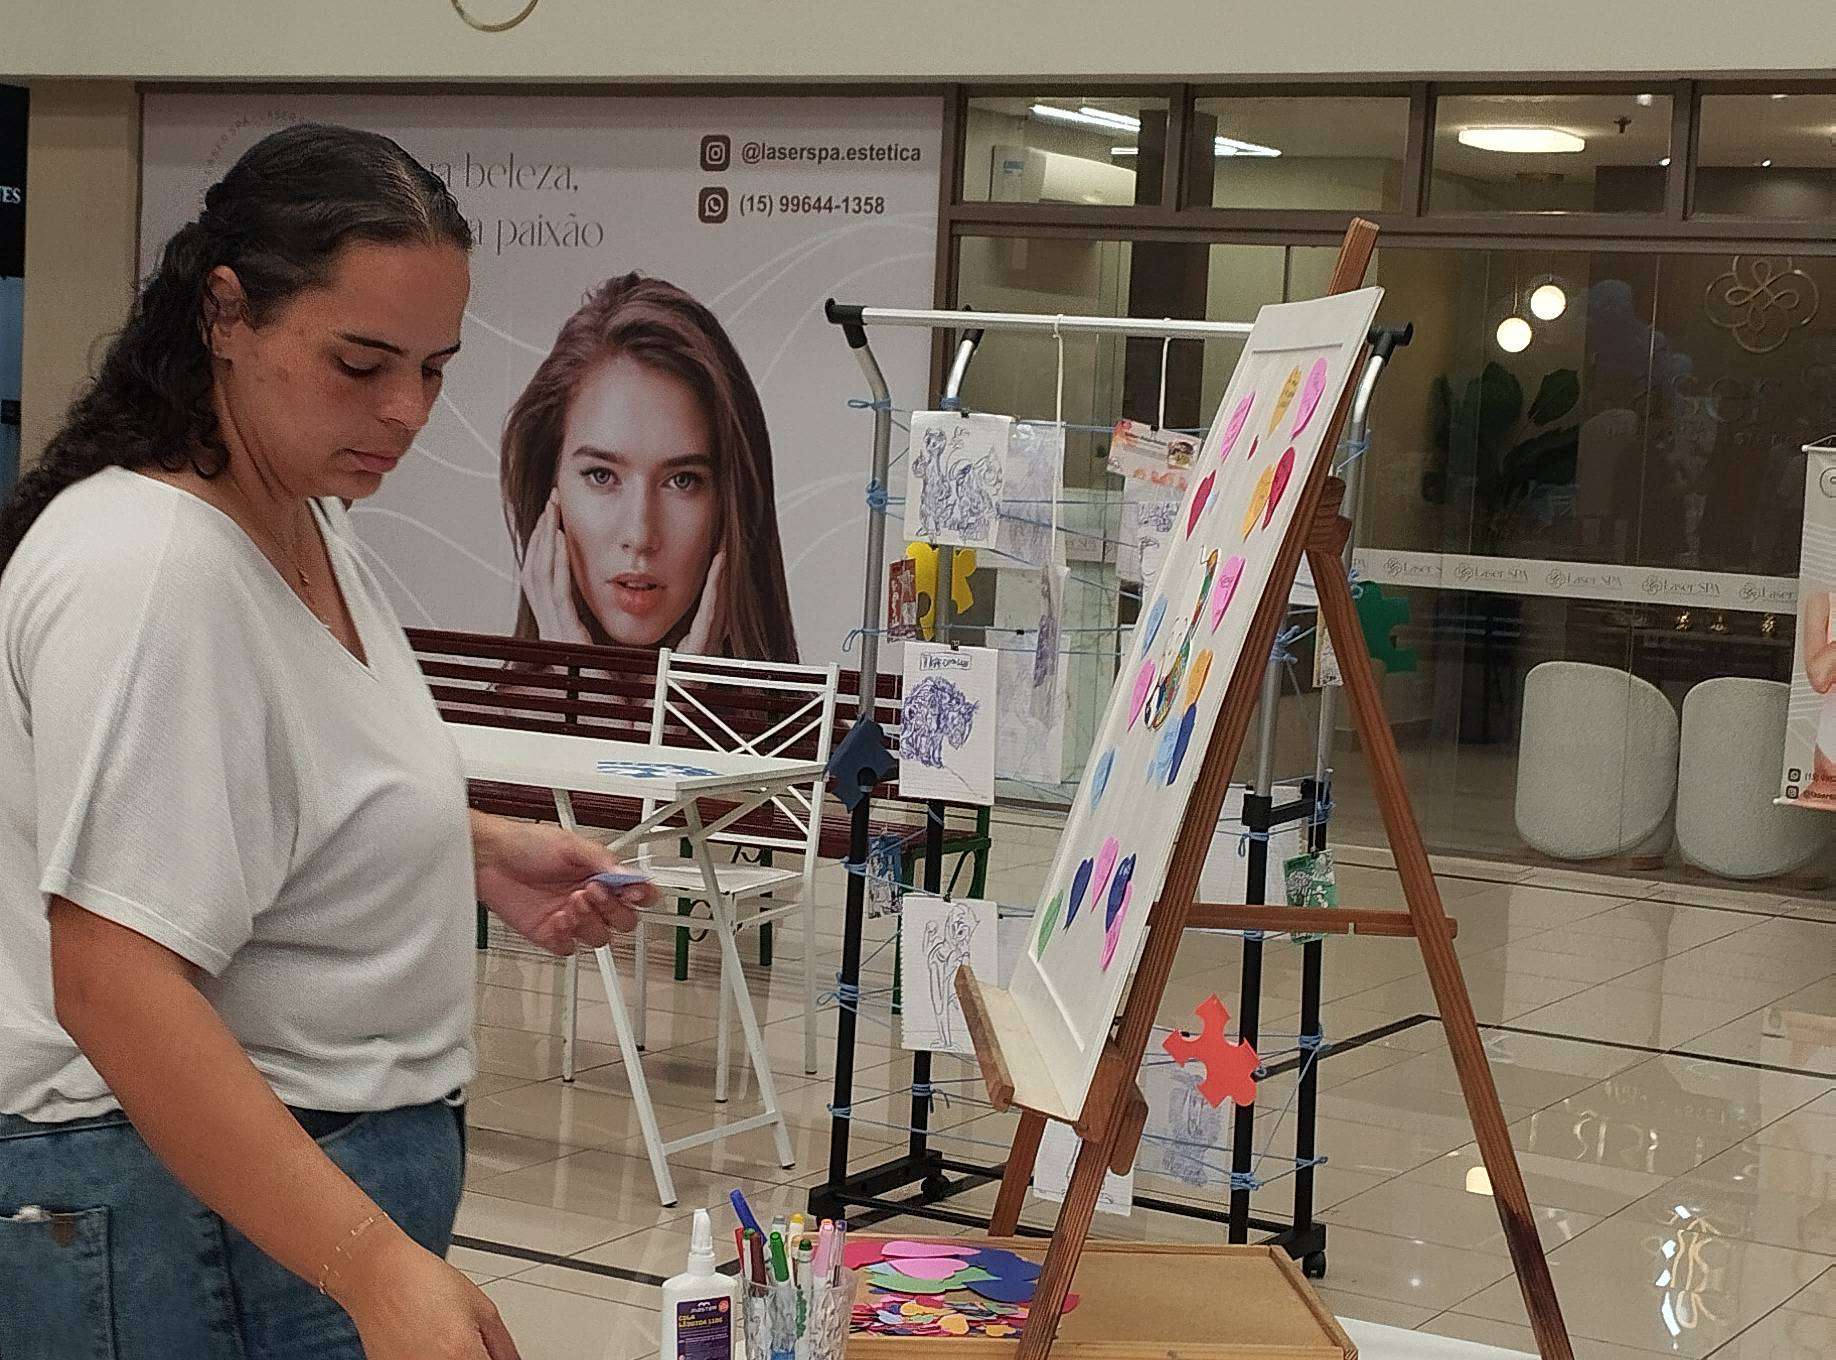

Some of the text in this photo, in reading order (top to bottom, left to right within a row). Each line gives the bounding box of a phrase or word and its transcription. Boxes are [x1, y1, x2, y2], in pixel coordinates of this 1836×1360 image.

[741, 142, 921, 165] @laserspa.estetica
[465, 152, 579, 193] beleza,
[739, 194, 885, 217] (15) 99644-1358
[496, 213, 604, 257] paixão
